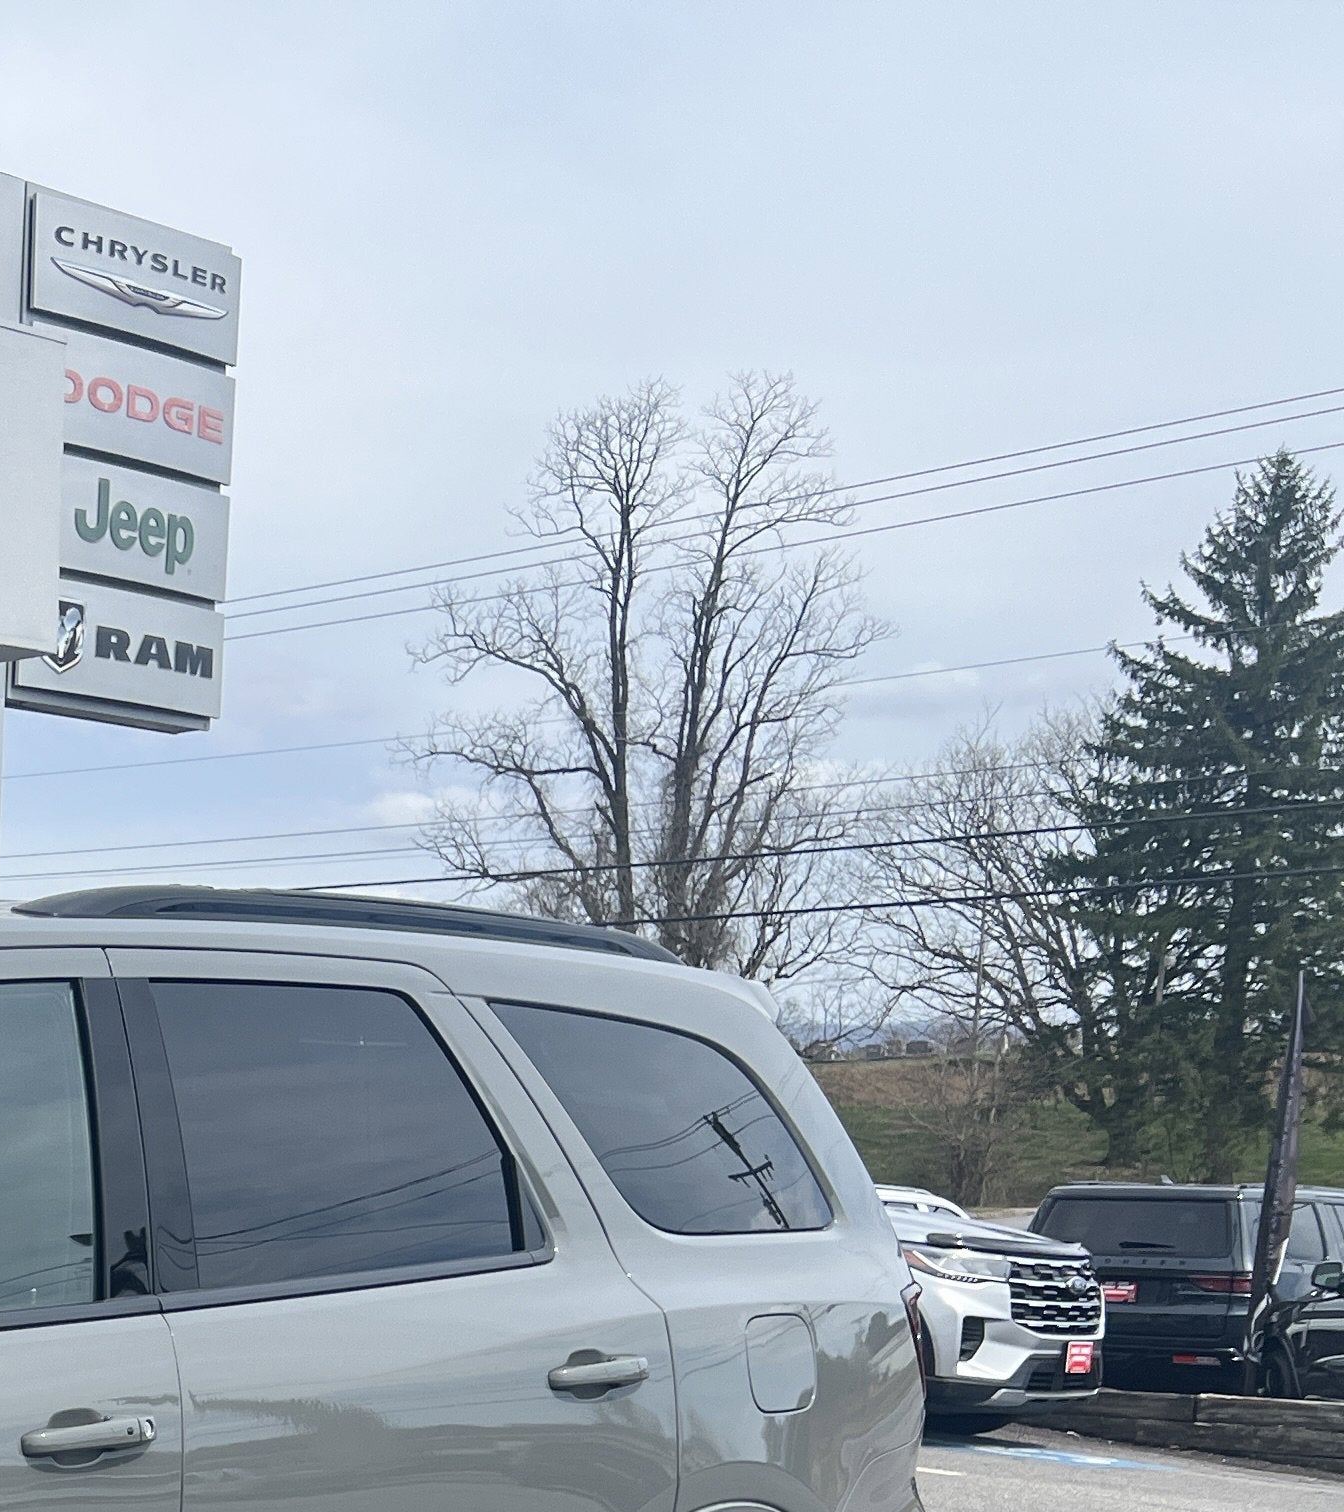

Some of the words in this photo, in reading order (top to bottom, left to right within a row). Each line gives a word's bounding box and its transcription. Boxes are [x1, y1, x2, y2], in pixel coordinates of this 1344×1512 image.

[54, 225, 227, 295] CHRYSLER
[74, 478, 195, 575] Jeep
[94, 625, 214, 680] RAM
